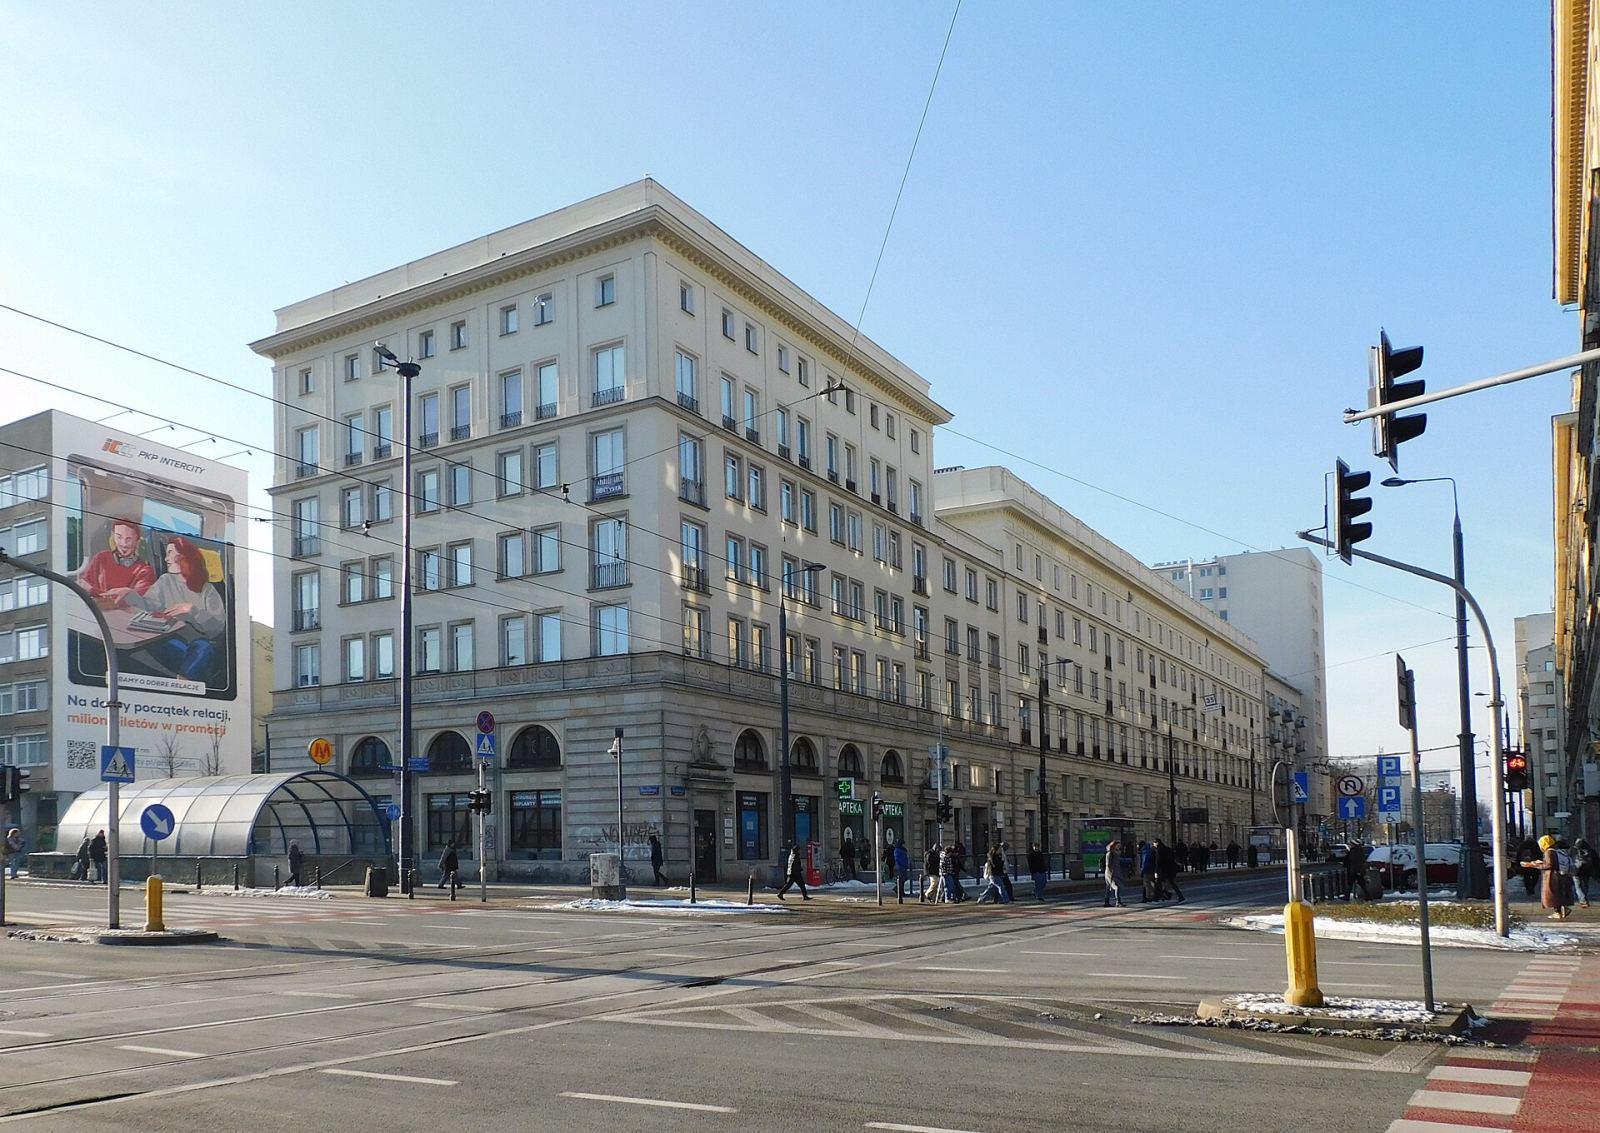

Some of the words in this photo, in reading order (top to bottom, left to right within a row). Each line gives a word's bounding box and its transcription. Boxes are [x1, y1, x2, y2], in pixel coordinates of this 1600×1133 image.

[138, 450, 159, 461] PKP
[160, 457, 205, 474] INTERCITY
[171, 682, 200, 691] RELACJE
[67, 694, 87, 708] Na
[90, 697, 131, 713] doy
[134, 700, 190, 718] początek
[192, 709, 232, 722] relacji,
[67, 713, 108, 726] milion
[112, 716, 159, 731] iletów
[161, 722, 173, 731] w
[175, 723, 227, 738] promocji
[314, 742, 331, 760] M
[1382, 759, 1396, 774] P
[1382, 789, 1396, 804] P
[839, 802, 862, 813] APTEKA
